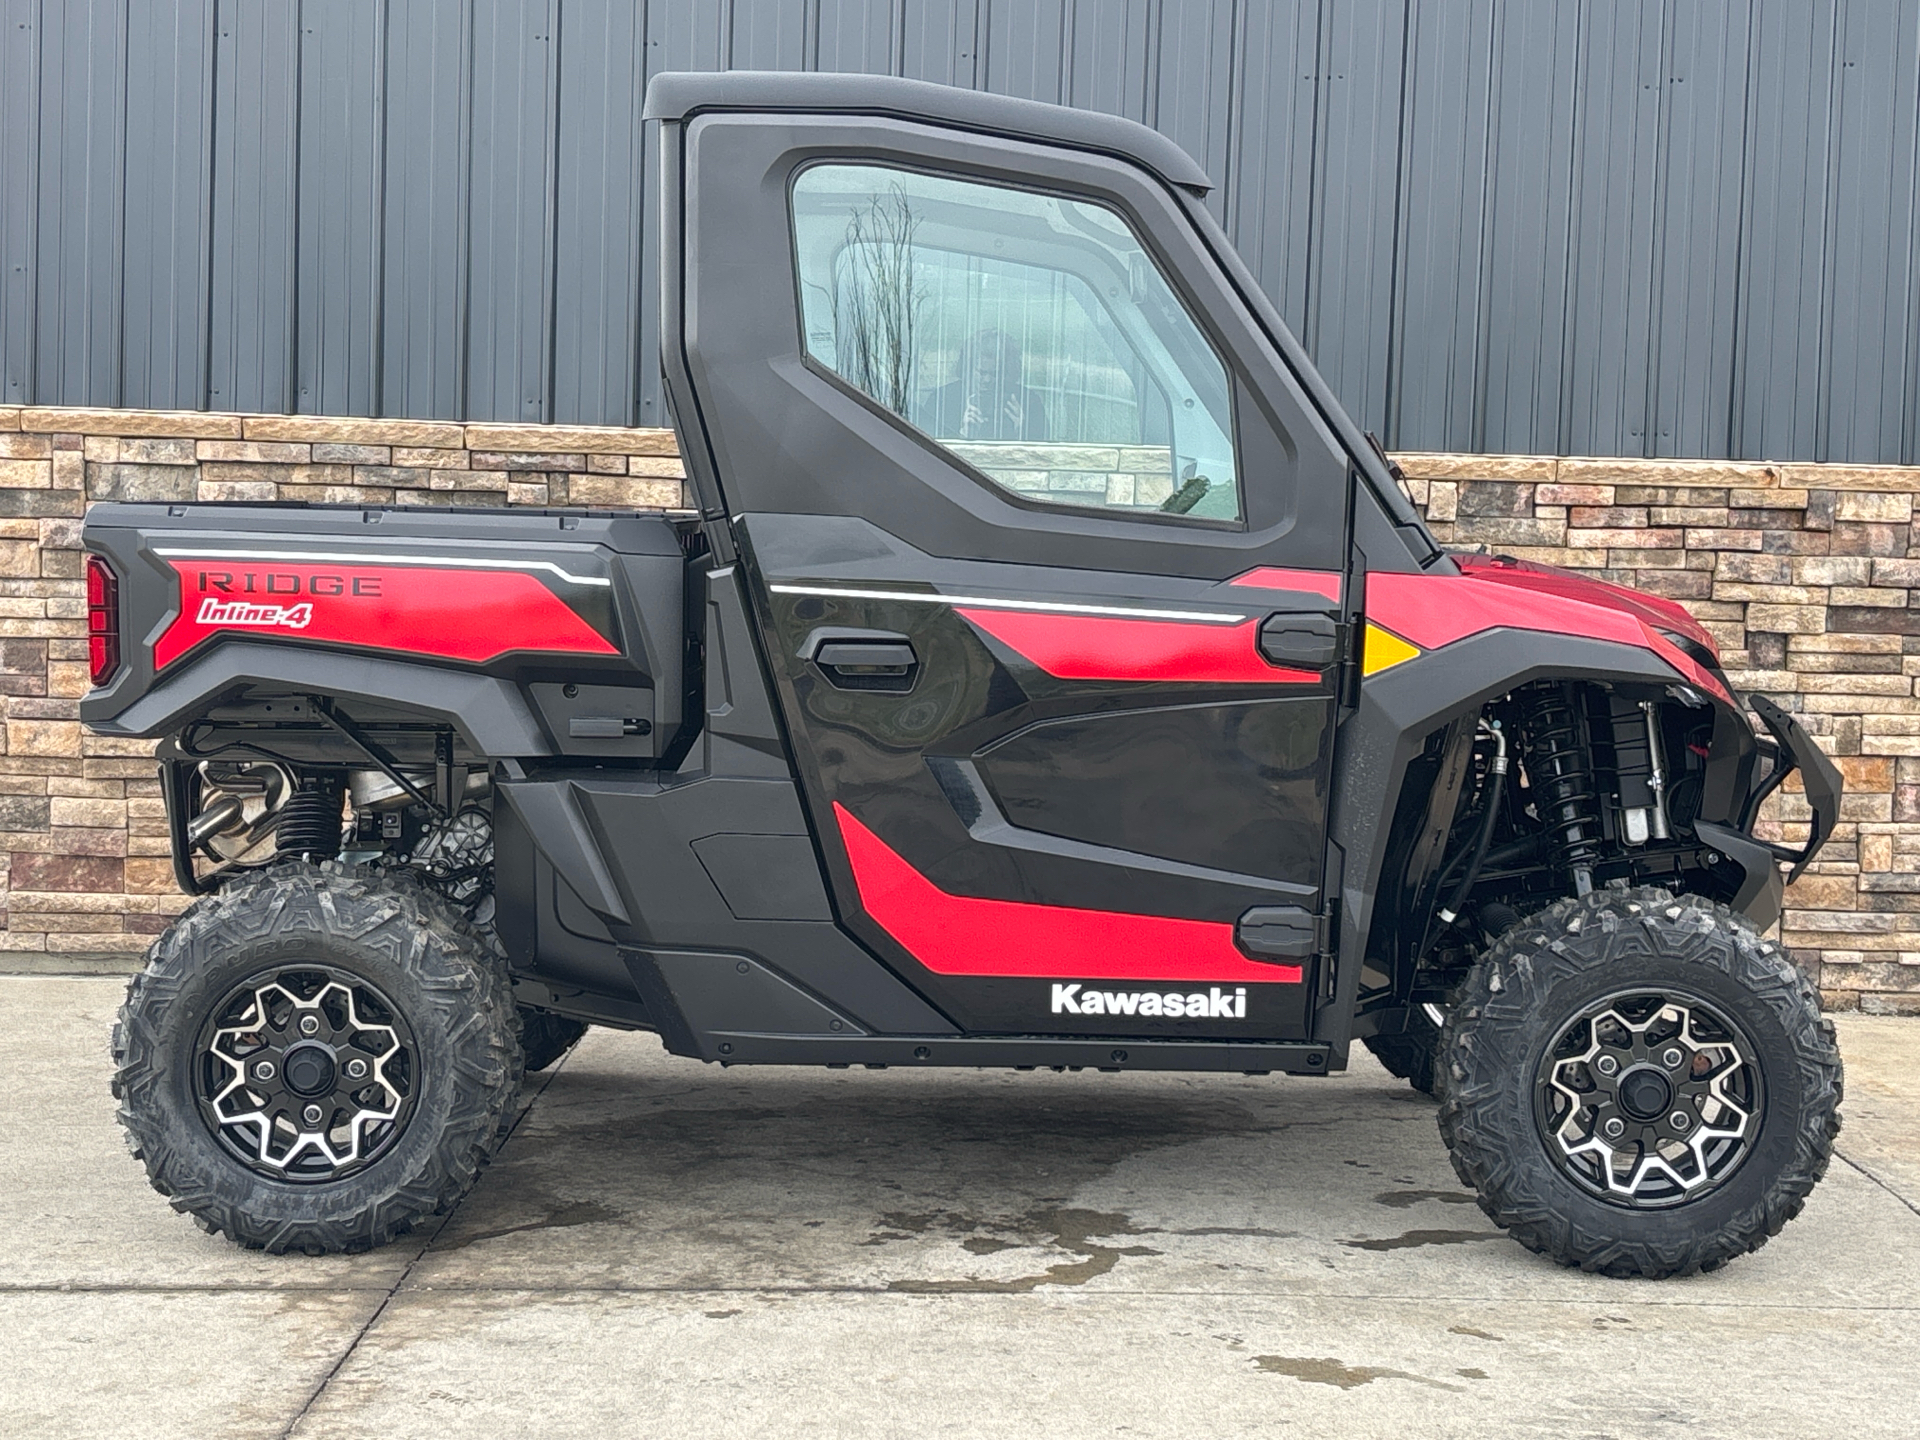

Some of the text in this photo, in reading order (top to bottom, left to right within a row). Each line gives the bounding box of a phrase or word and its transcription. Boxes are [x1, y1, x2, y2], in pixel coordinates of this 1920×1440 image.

[199, 572, 382, 597] RIDGE
[196, 598, 313, 629] Inline-4
[1051, 983, 1247, 1018] Kawasaki
